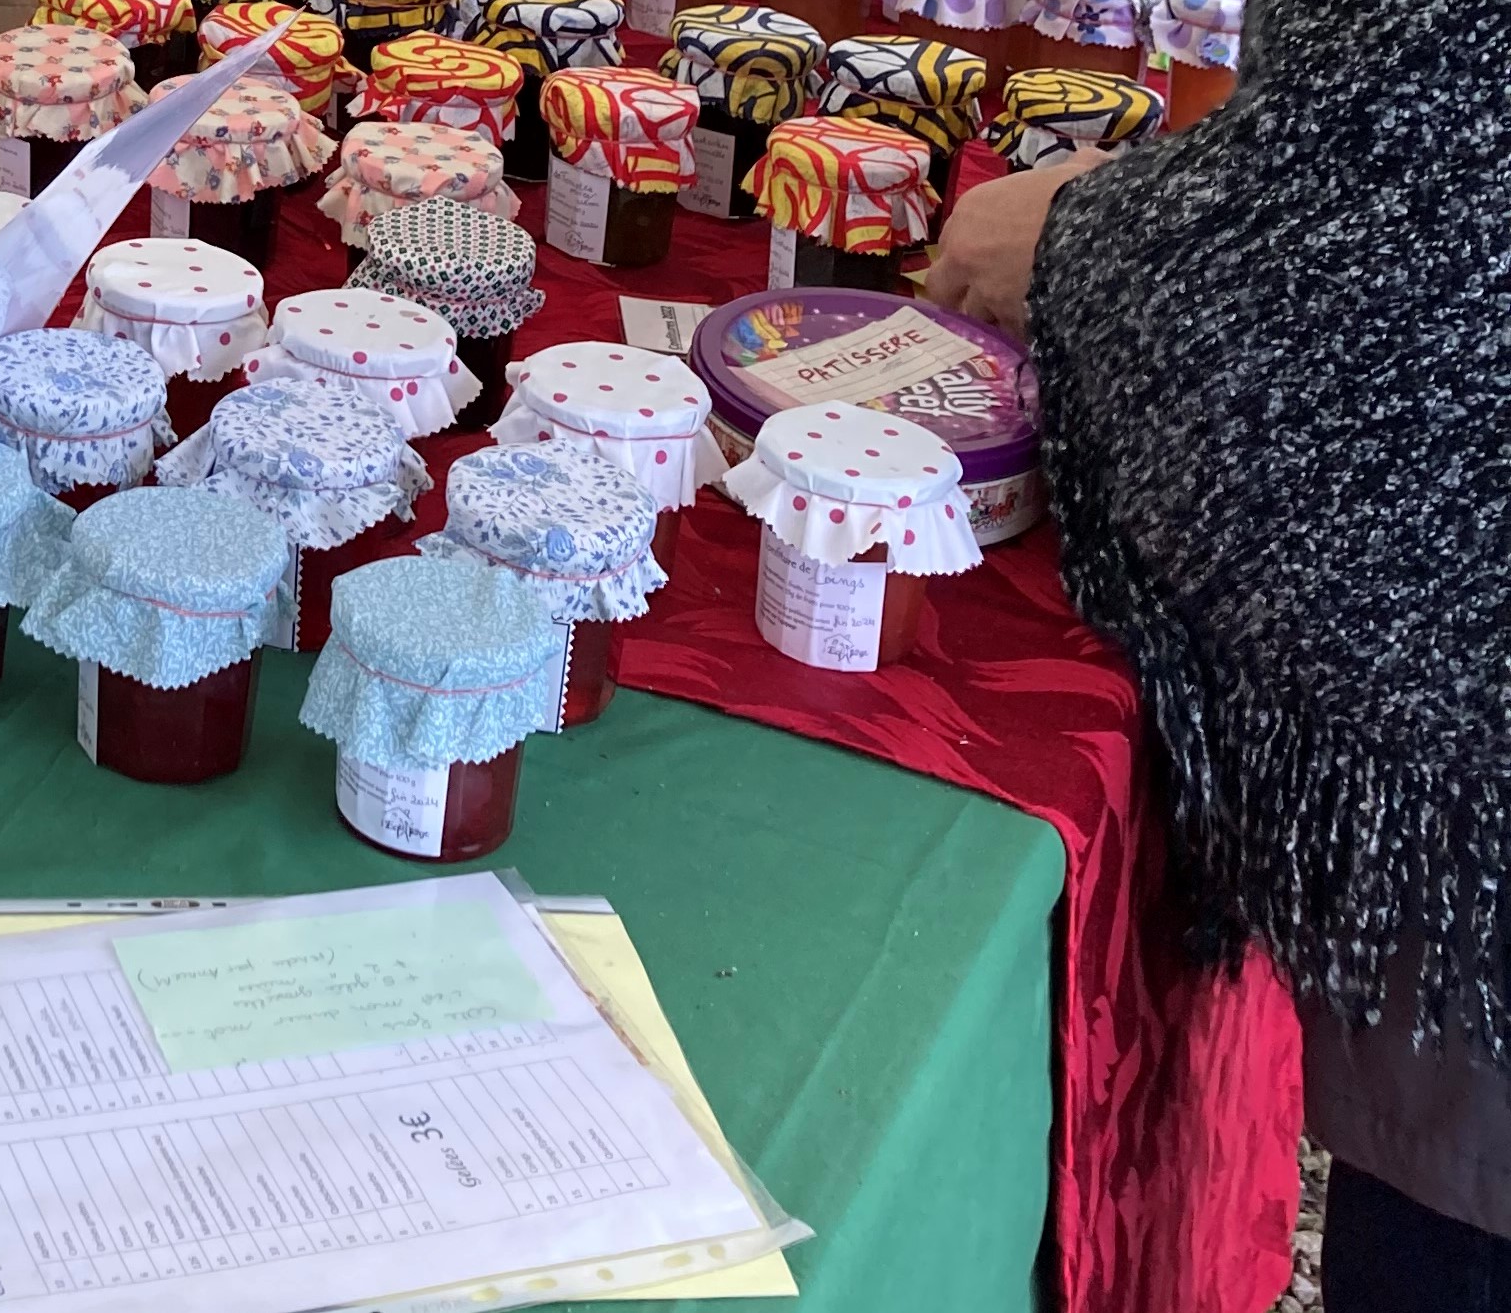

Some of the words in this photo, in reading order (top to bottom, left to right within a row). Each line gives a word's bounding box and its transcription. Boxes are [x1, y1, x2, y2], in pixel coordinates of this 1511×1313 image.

[898, 382, 954, 417] eet
[933, 366, 1003, 421] ality
[799, 562, 812, 575] de
[398, 1111, 444, 1143] 3€
[440, 1147, 482, 1188] Gelées
